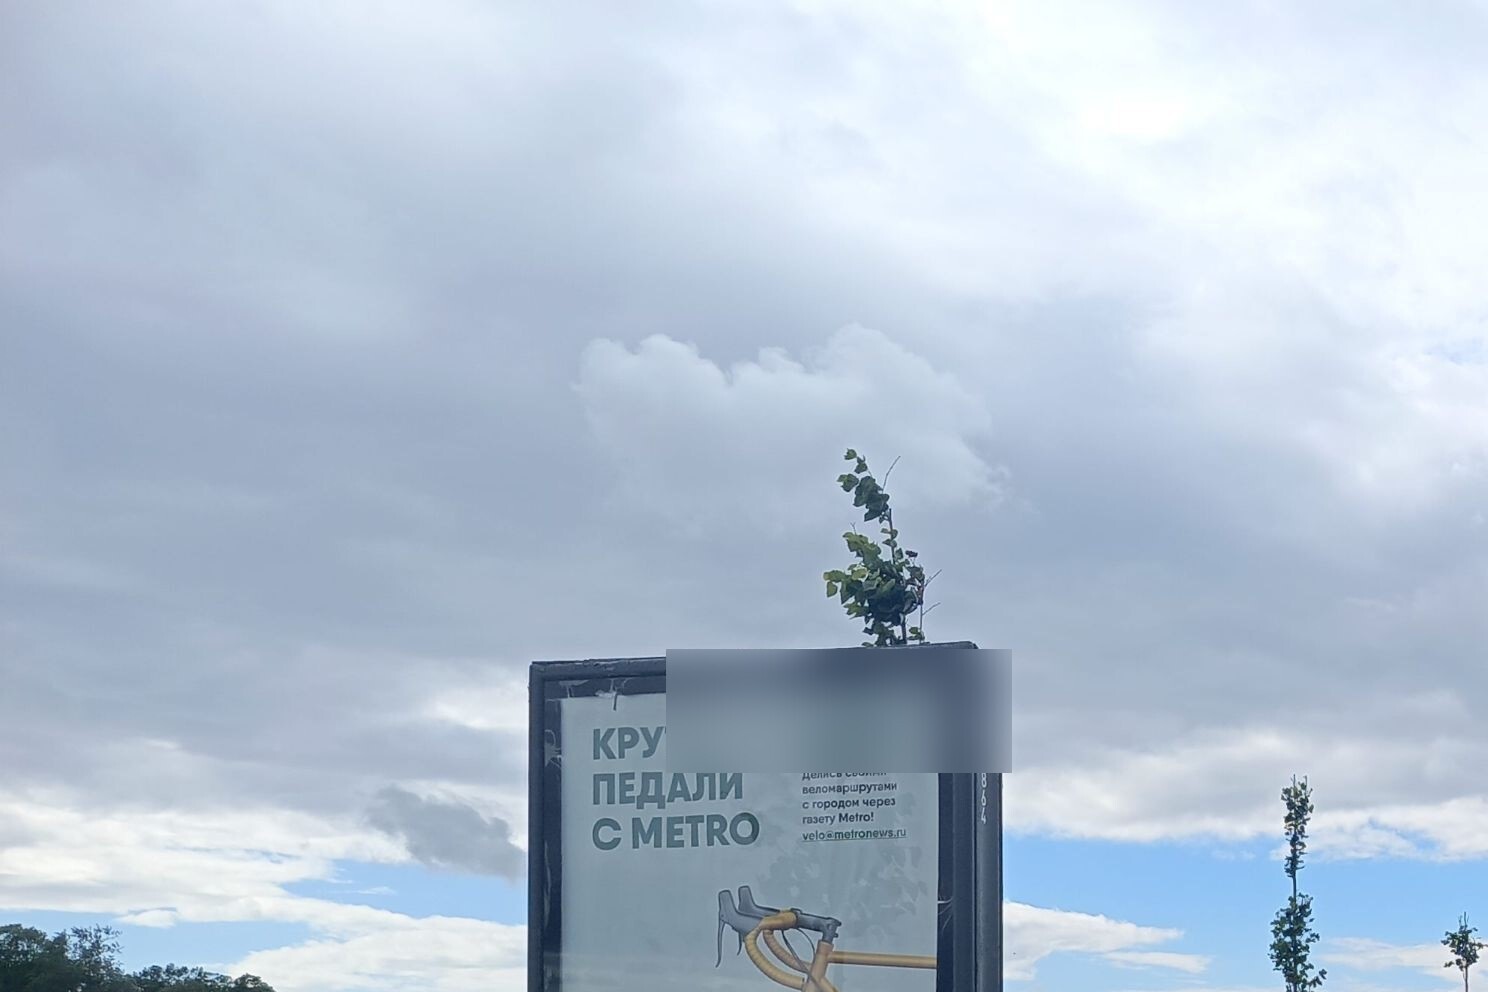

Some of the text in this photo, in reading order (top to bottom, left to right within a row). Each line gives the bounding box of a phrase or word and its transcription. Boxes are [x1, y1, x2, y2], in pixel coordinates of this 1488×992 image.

[592, 726, 666, 761] КРУ
[592, 772, 744, 810] ПЕДАЛИ
[802, 783, 897, 795] веломаршрутами
[802, 797, 896, 810] с городом через
[802, 811, 874, 825] газету Metro!
[592, 812, 760, 851] С METRO
[802, 829, 907, 841] velo@metronews.ru
